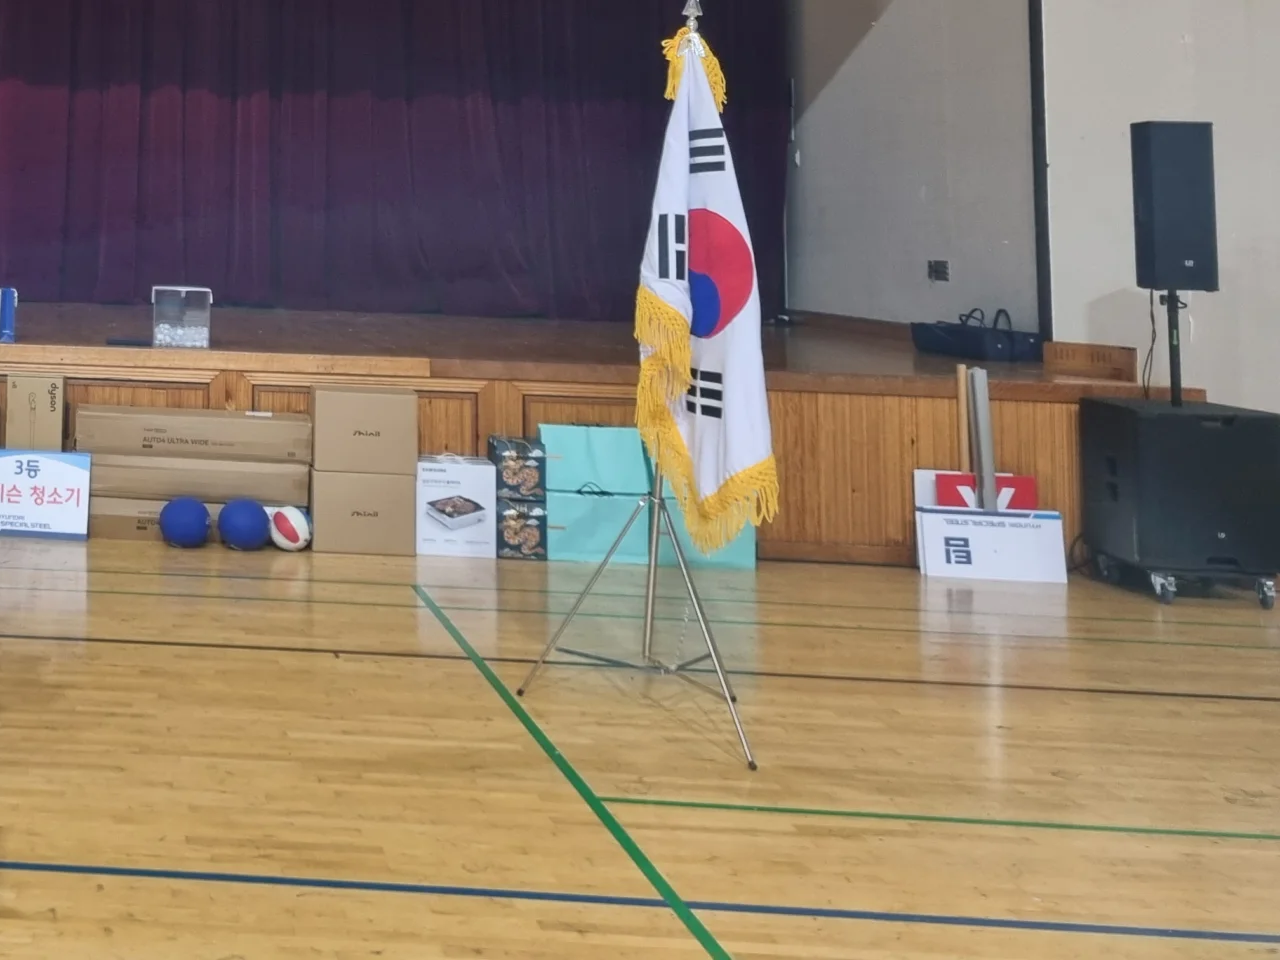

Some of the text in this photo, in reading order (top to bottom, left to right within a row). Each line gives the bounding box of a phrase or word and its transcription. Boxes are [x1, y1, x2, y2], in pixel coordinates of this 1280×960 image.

[47, 382, 60, 413] dyson
[13, 458, 42, 480] 3등
[29, 484, 82, 508] 청소기
